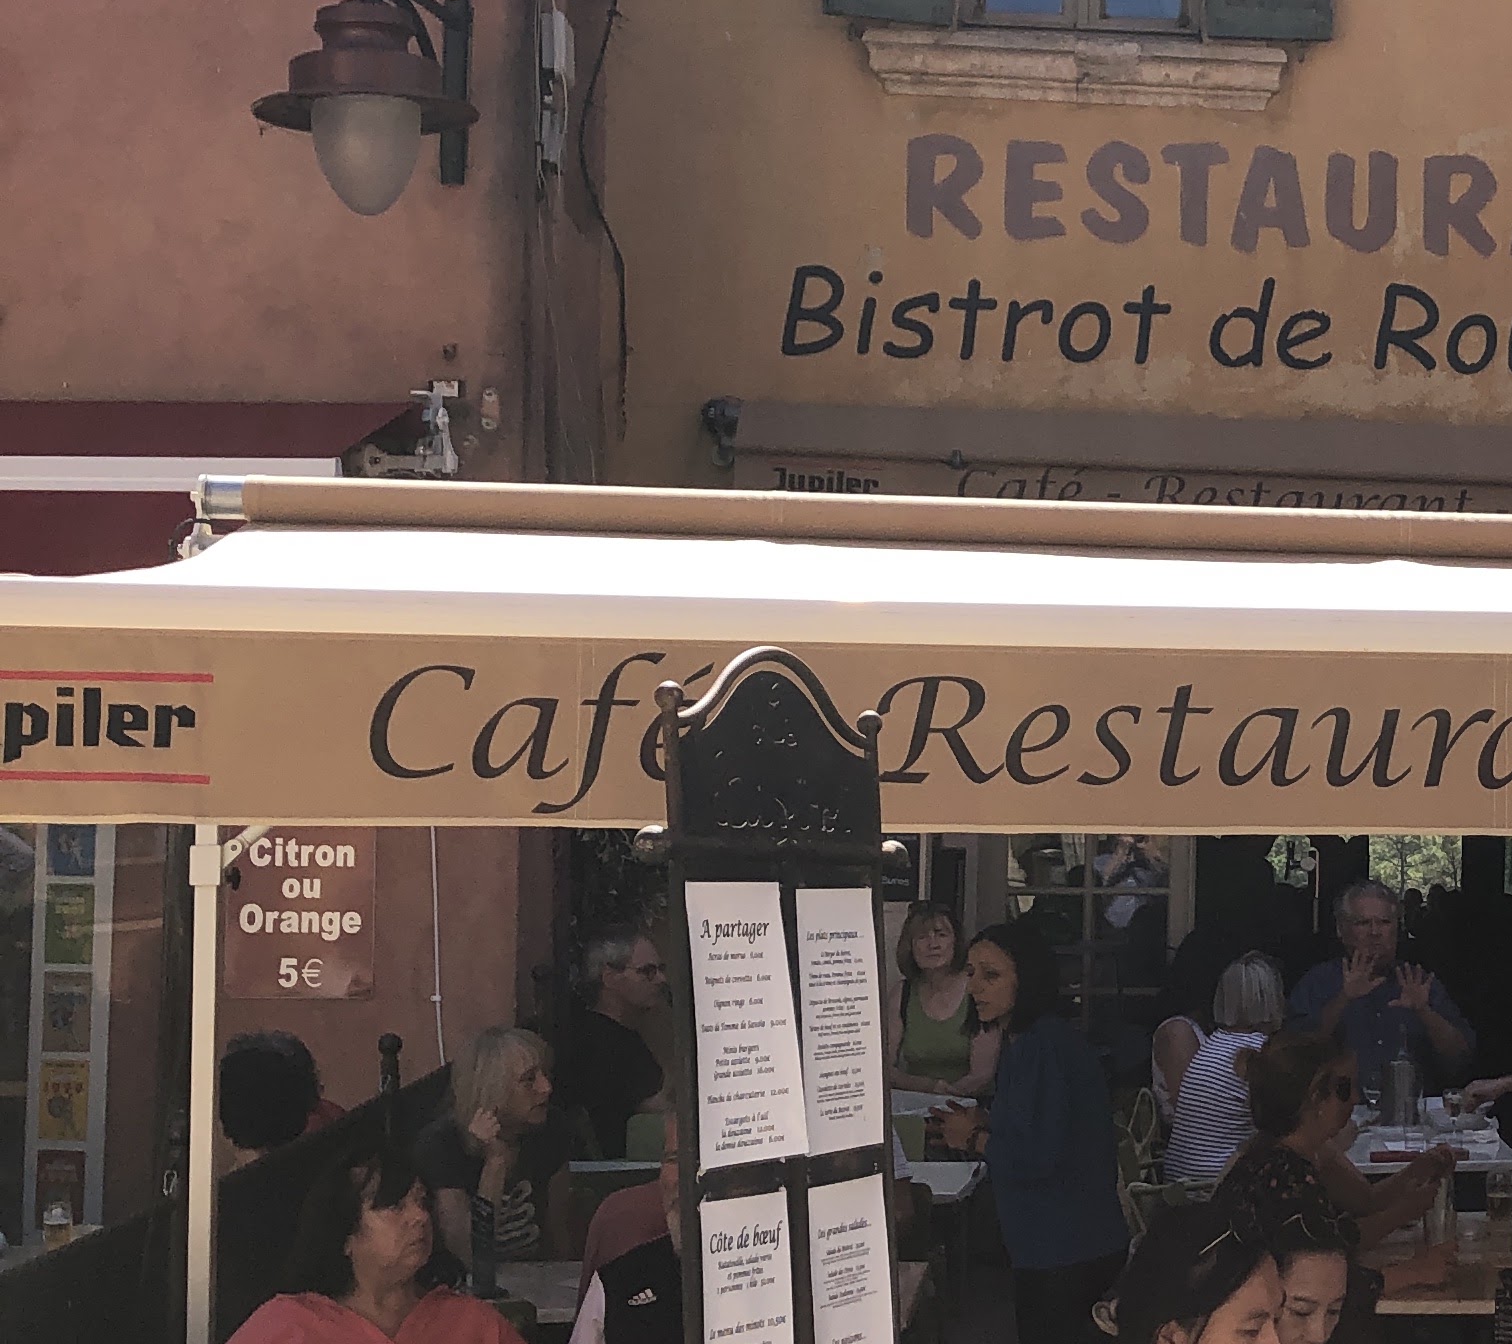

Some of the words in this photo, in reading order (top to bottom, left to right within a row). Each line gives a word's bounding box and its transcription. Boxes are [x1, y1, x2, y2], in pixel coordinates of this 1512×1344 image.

[780, 265, 1172, 369] Bistrot
[1210, 278, 1334, 370] de
[369, 652, 714, 814] Café
[249, 837, 355, 867] Citron
[281, 877, 321, 899] ou
[239, 903, 362, 941] Orange
[700, 919, 712, 939] A
[712, 919, 770, 946] partager
[277, 957, 324, 988] 5€
[709, 1230, 734, 1254] Côte
[737, 1225, 750, 1250] de
[753, 1220, 783, 1251] bœuf
